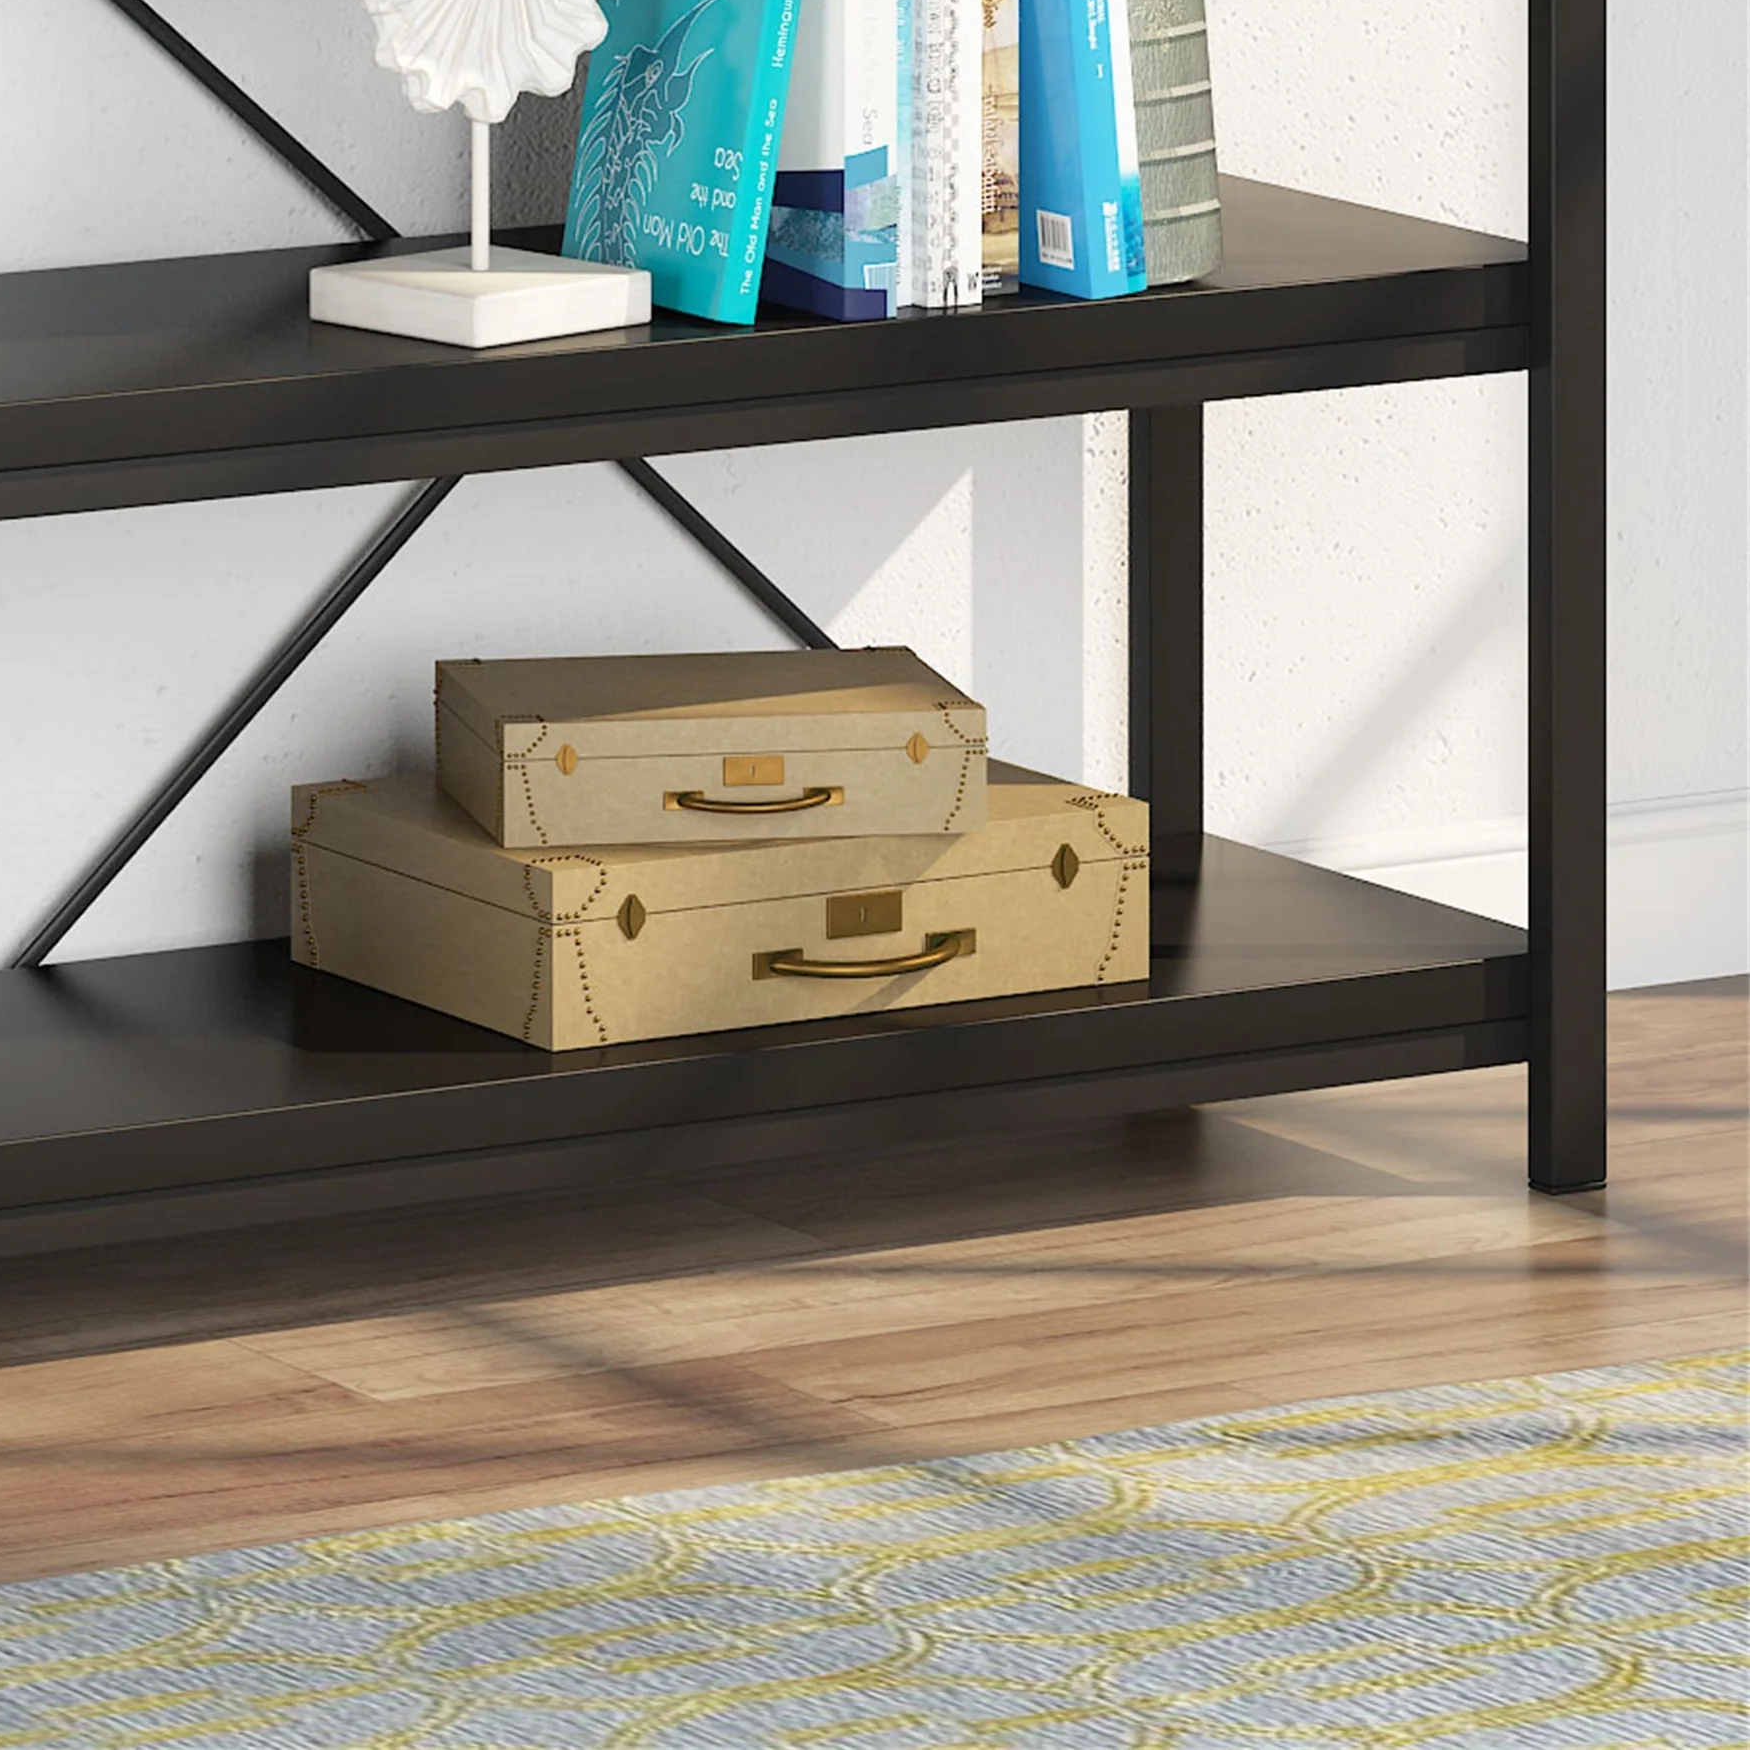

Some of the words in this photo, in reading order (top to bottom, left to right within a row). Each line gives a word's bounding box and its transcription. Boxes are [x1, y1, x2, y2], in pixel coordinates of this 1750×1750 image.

[764, 98, 778, 128] Sea
[862, 108, 878, 145] Sea
[762, 133, 773, 157] the
[713, 147, 744, 182] Sea
[757, 161, 769, 191] and
[690, 182, 709, 209] the
[711, 188, 736, 211] and
[751, 197, 763, 230] Man
[643, 213, 674, 249] Man
[676, 222, 705, 256] Old
[709, 229, 730, 257] The
[745, 235, 758, 263] Old
[740, 269, 753, 296] The
